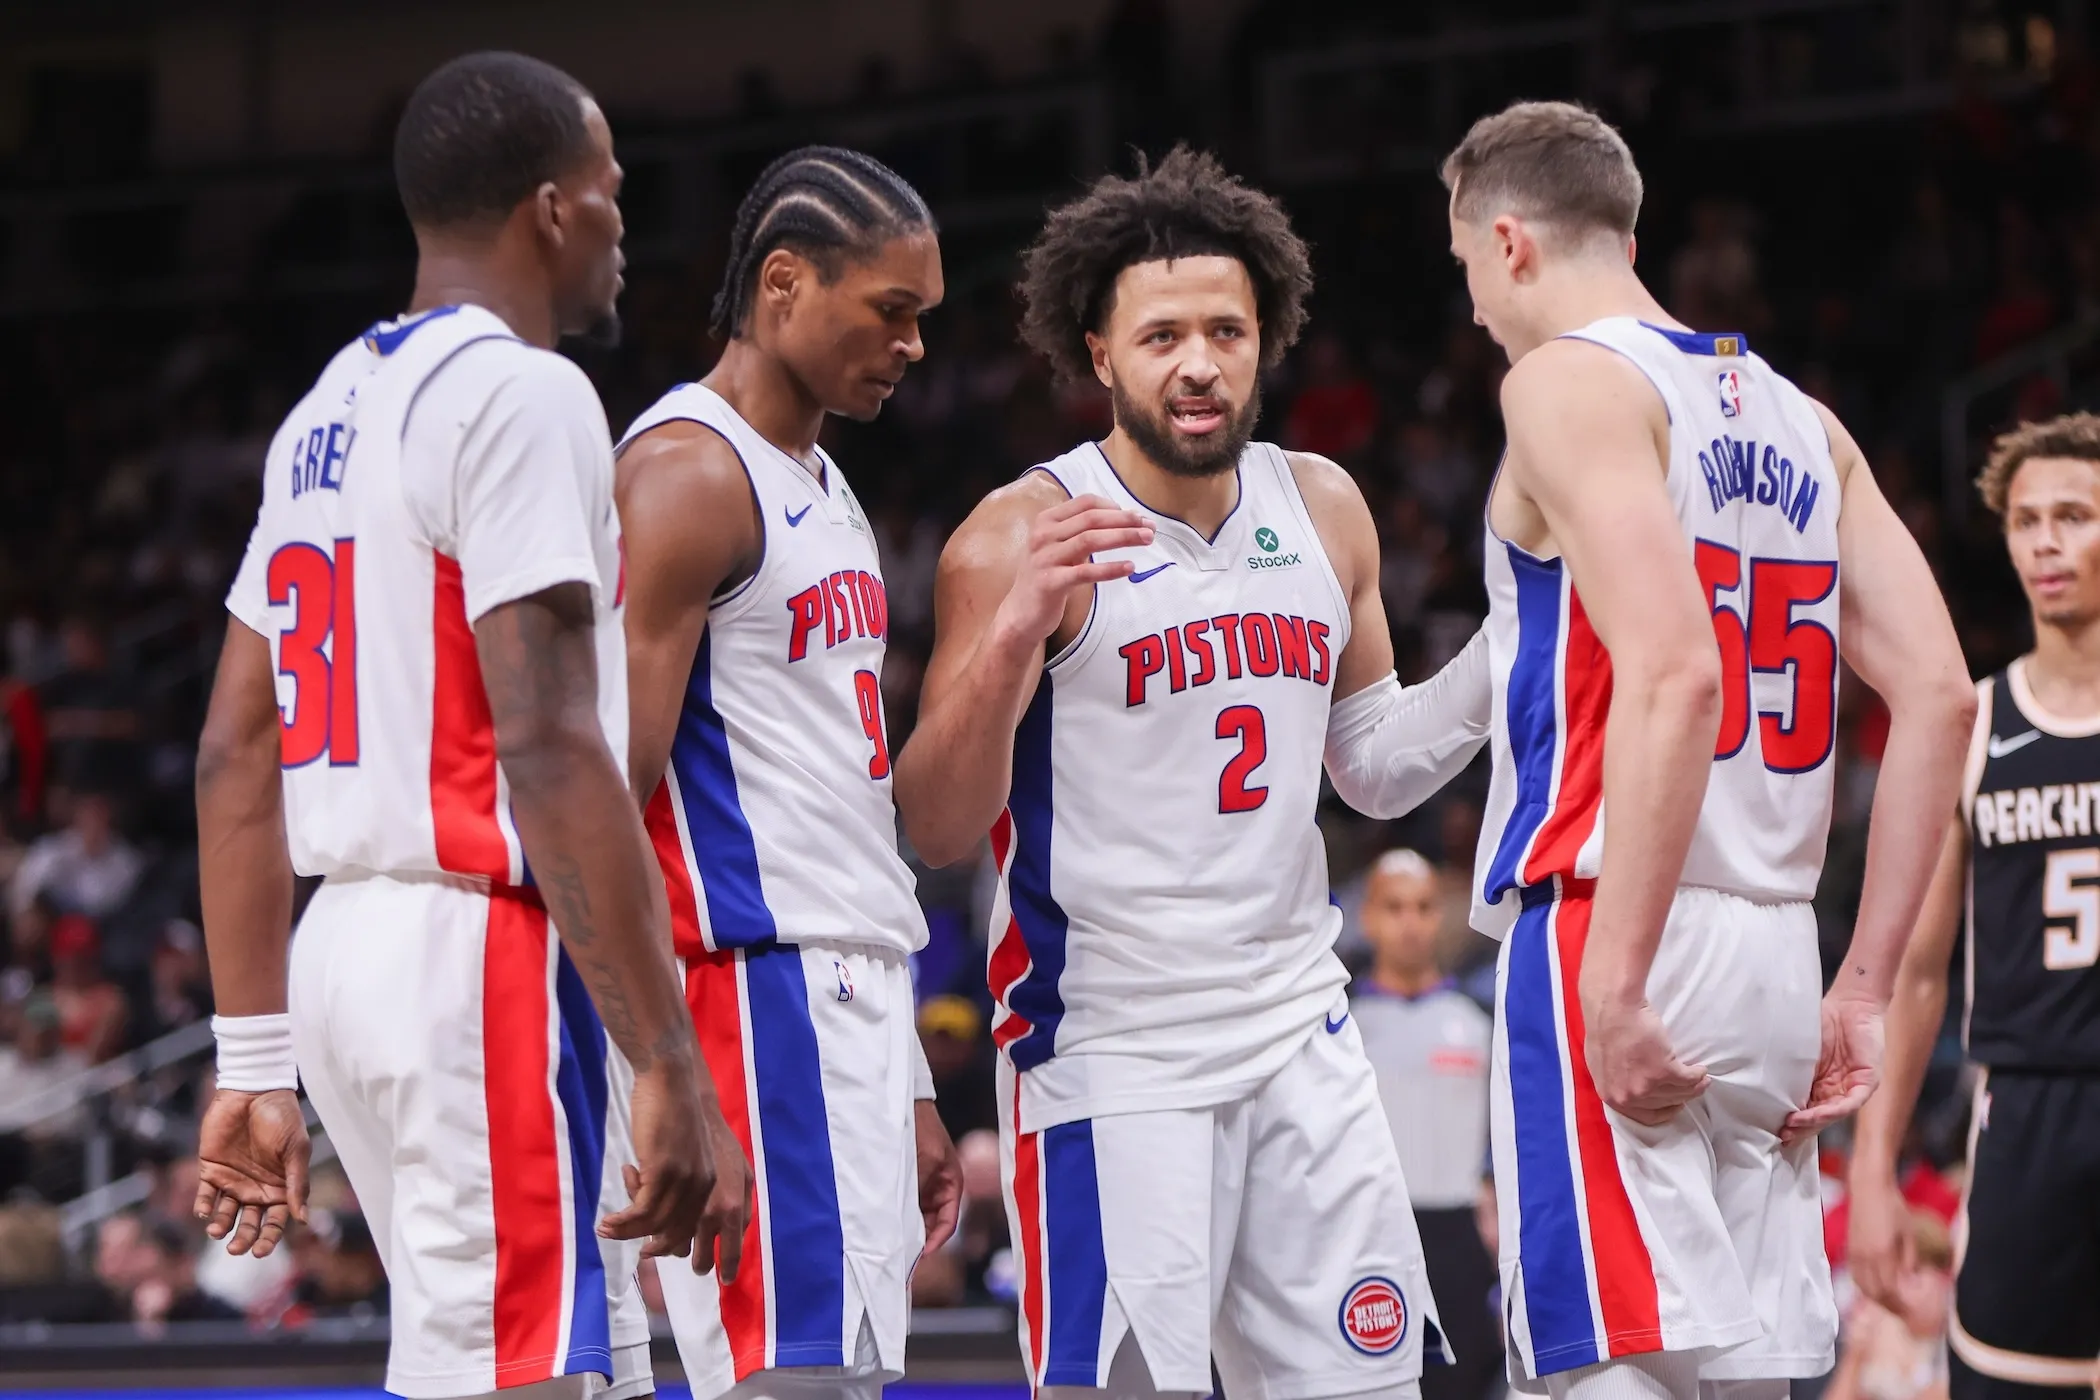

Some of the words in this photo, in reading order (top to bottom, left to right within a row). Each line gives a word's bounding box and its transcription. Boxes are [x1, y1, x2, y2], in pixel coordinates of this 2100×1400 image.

[293, 423, 357, 500] GRE
[1698, 434, 1819, 534] ROBNSON
[1248, 552, 1302, 569] StockX
[267, 536, 360, 770] 31
[1119, 613, 1330, 708] PISTONS
[854, 669, 889, 781] 9
[1215, 704, 1269, 815] 2
[2043, 847, 2100, 971] 5
[1355, 1313, 1398, 1335] PISTONS
